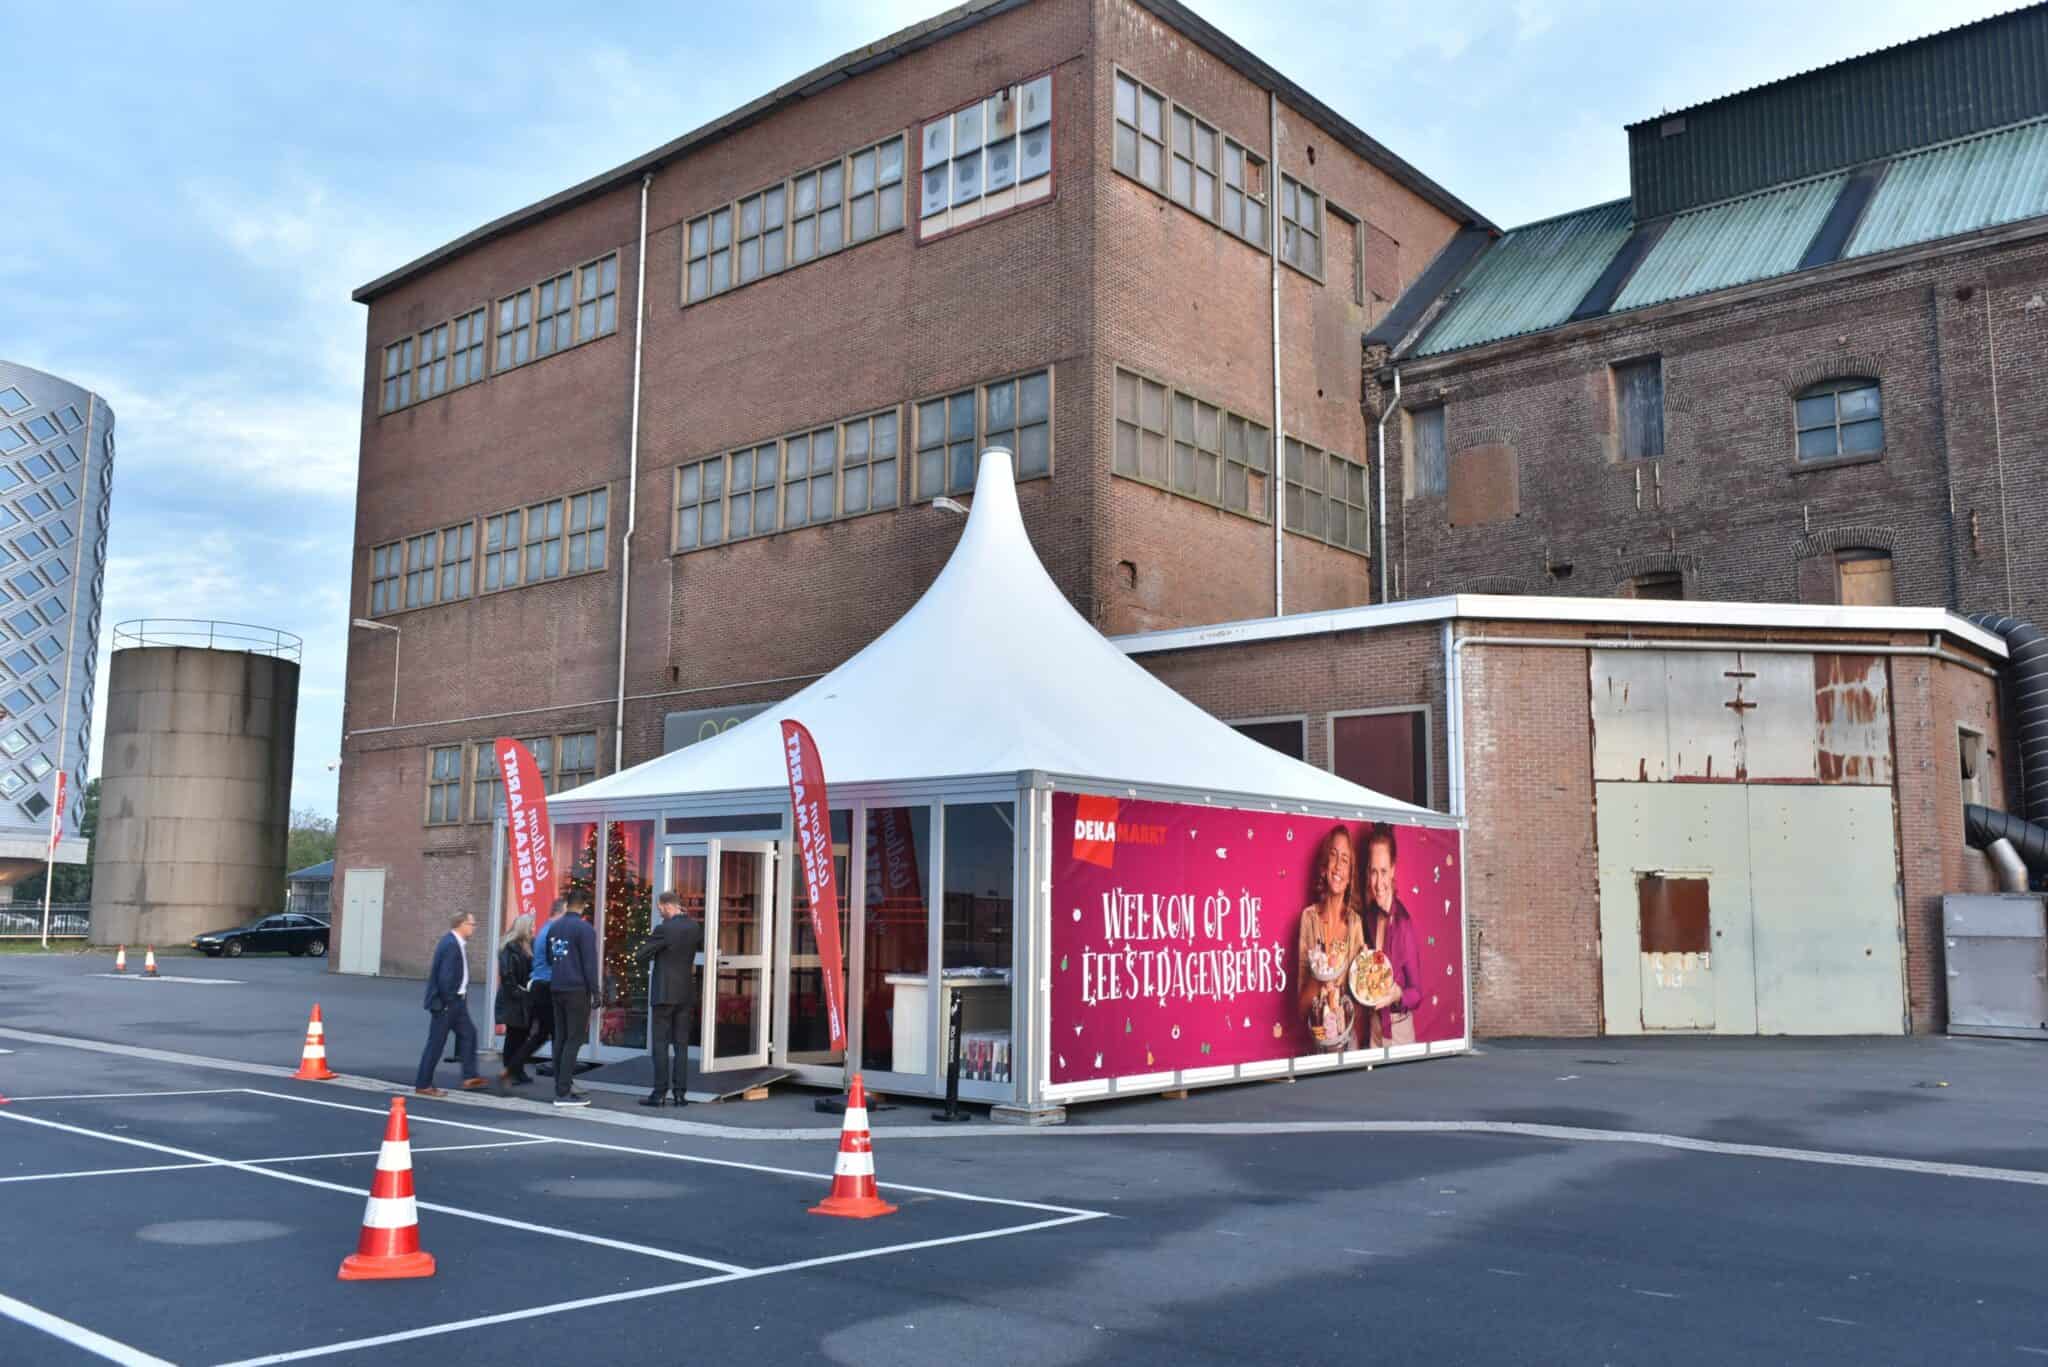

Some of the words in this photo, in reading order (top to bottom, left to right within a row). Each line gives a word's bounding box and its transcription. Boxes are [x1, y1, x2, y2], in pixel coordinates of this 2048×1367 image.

[1101, 888, 1196, 946] WELKOM
[1203, 889, 1231, 941] OP
[1239, 890, 1262, 945] DE
